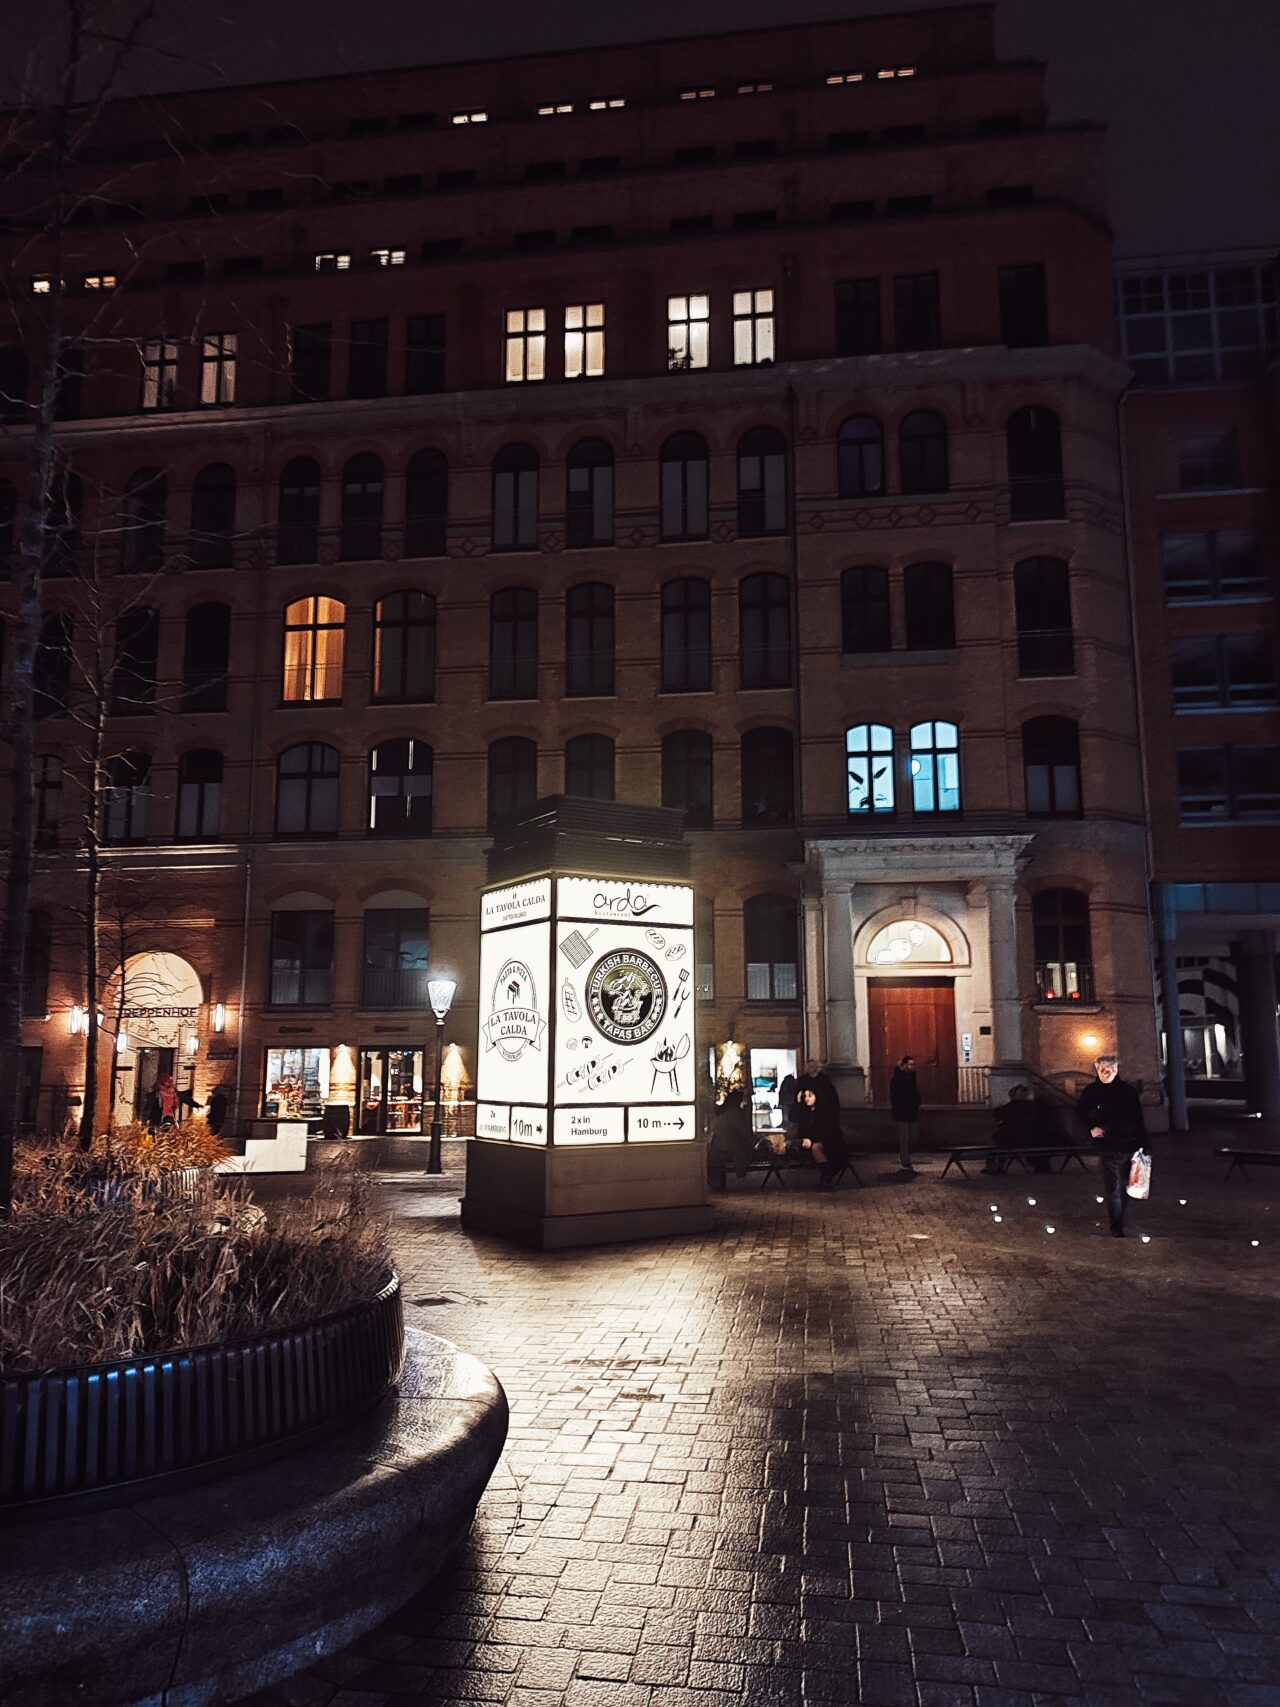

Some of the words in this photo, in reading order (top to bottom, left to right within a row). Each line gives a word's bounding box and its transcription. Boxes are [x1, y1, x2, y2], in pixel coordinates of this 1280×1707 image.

[486, 907, 495, 915] LA
[496, 900, 521, 913] TAVOLA
[522, 895, 546, 907] CALDA
[593, 888, 657, 914] arda
[591, 955, 621, 994] TURKISH
[622, 954, 663, 998] BARBECUE
[119, 1007, 198, 1018] REPPENHOF
[490, 1014, 502, 1027] LA
[503, 1010, 536, 1025] TAVOLA
[500, 1024, 528, 1036] CALDA
[603, 1019, 633, 1039] TAPAS
[634, 1020, 656, 1038] BAR
[513, 1119, 533, 1137] 10m
[571, 1116, 576, 1124] 2
[583, 1115, 591, 1124] in
[636, 1118, 649, 1129] 10
[651, 1119, 662, 1129] m
[571, 1127, 608, 1137] Hamburg
